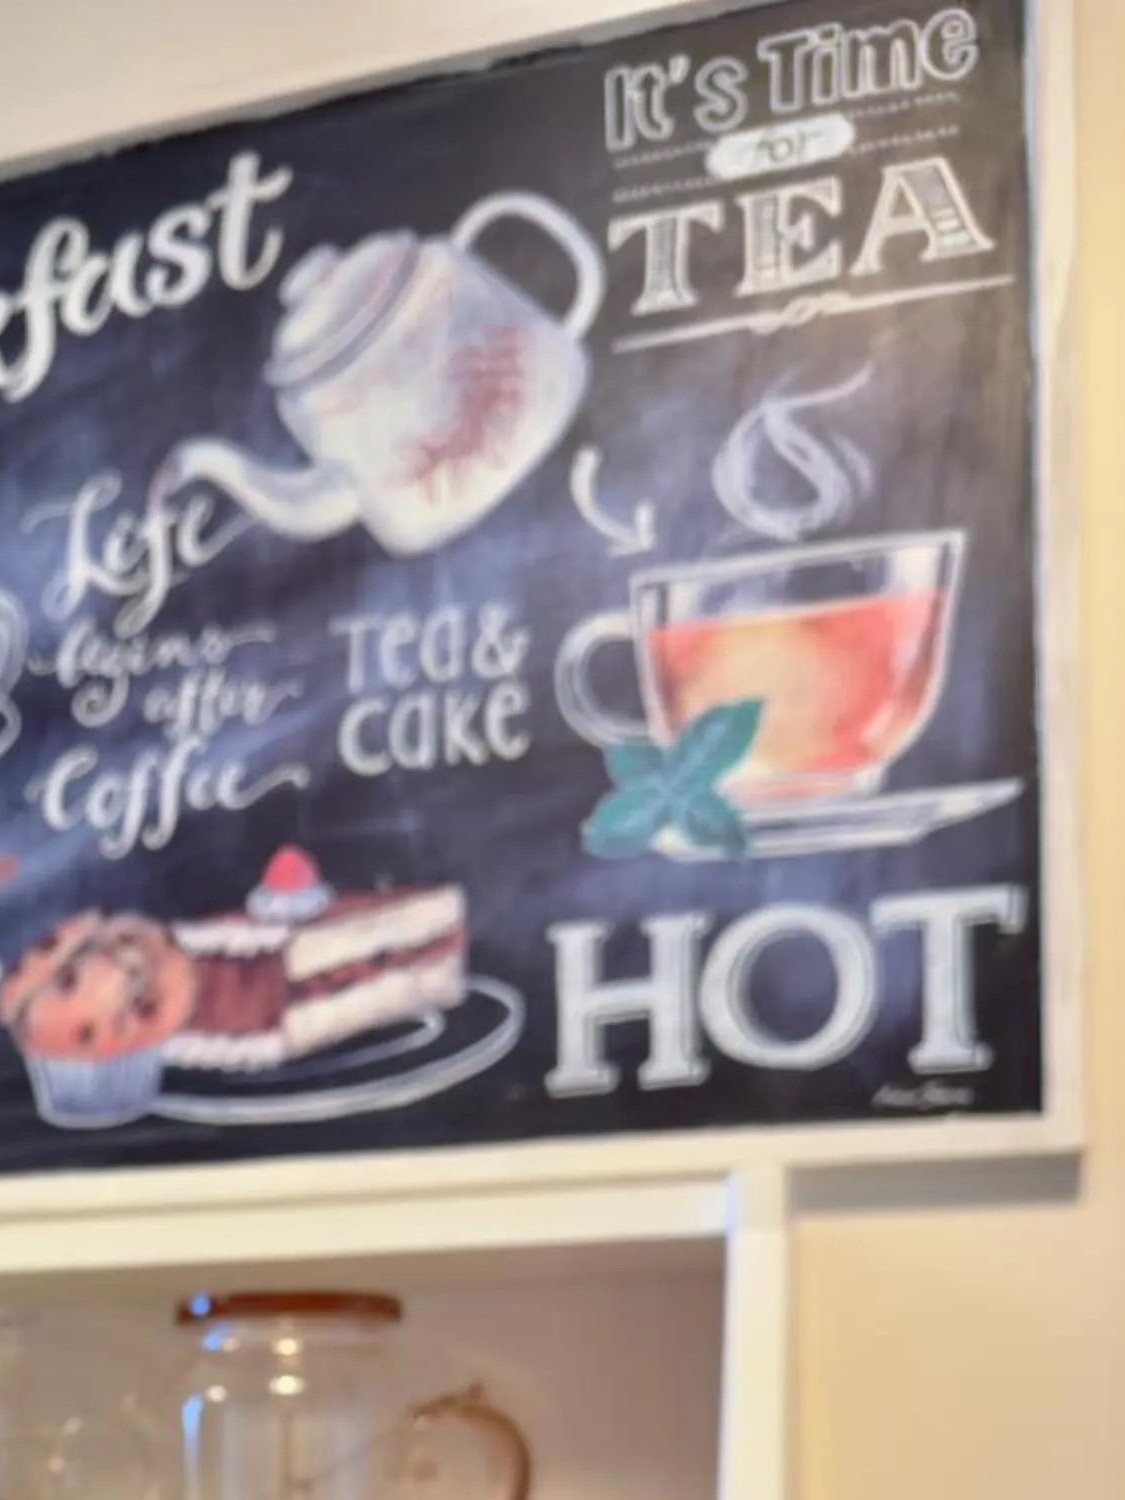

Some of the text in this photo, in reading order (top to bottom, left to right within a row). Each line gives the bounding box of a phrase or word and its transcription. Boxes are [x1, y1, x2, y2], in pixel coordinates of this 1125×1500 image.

[604, 8, 978, 152] It's Time
[607, 157, 996, 315] TEA
[545, 883, 1028, 1098] HOT
